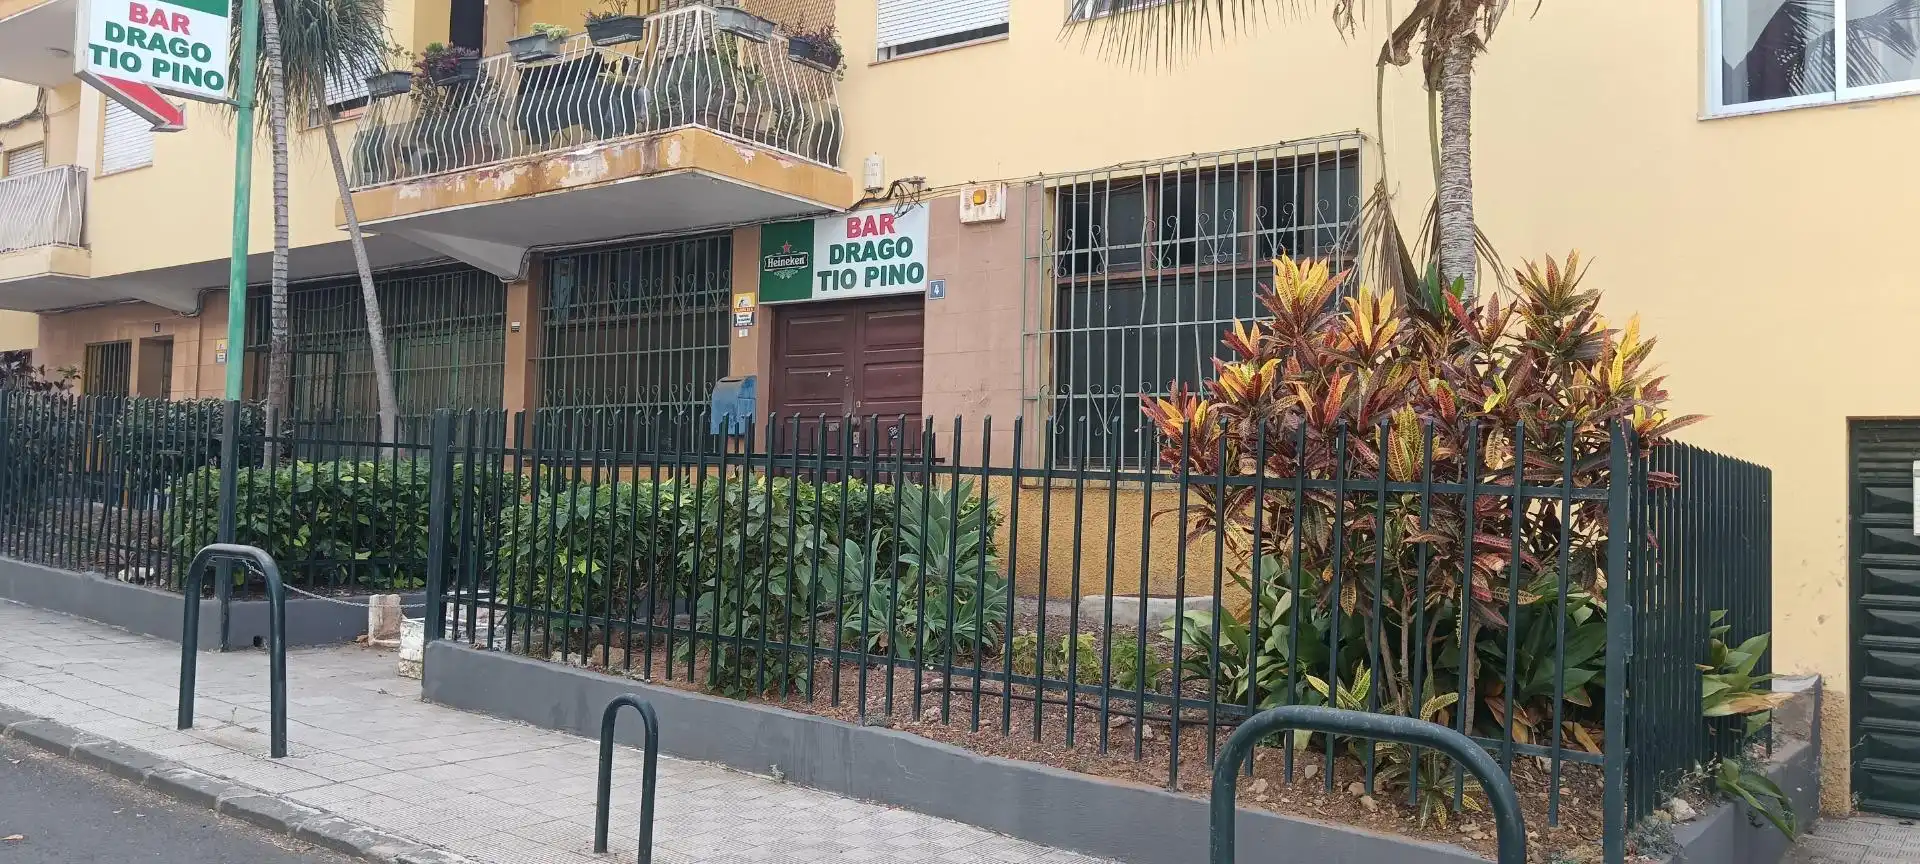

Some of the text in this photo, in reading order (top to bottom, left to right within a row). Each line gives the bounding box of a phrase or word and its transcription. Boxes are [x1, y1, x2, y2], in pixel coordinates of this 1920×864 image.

[129, 2, 190, 35] BAR
[105, 21, 212, 63] DRAGO
[88, 43, 224, 91] TIO PINO
[846, 213, 896, 239] BAR
[767, 256, 805, 268] Heineken
[829, 236, 913, 265] DRAGO
[817, 261, 925, 292] TIO PINO
